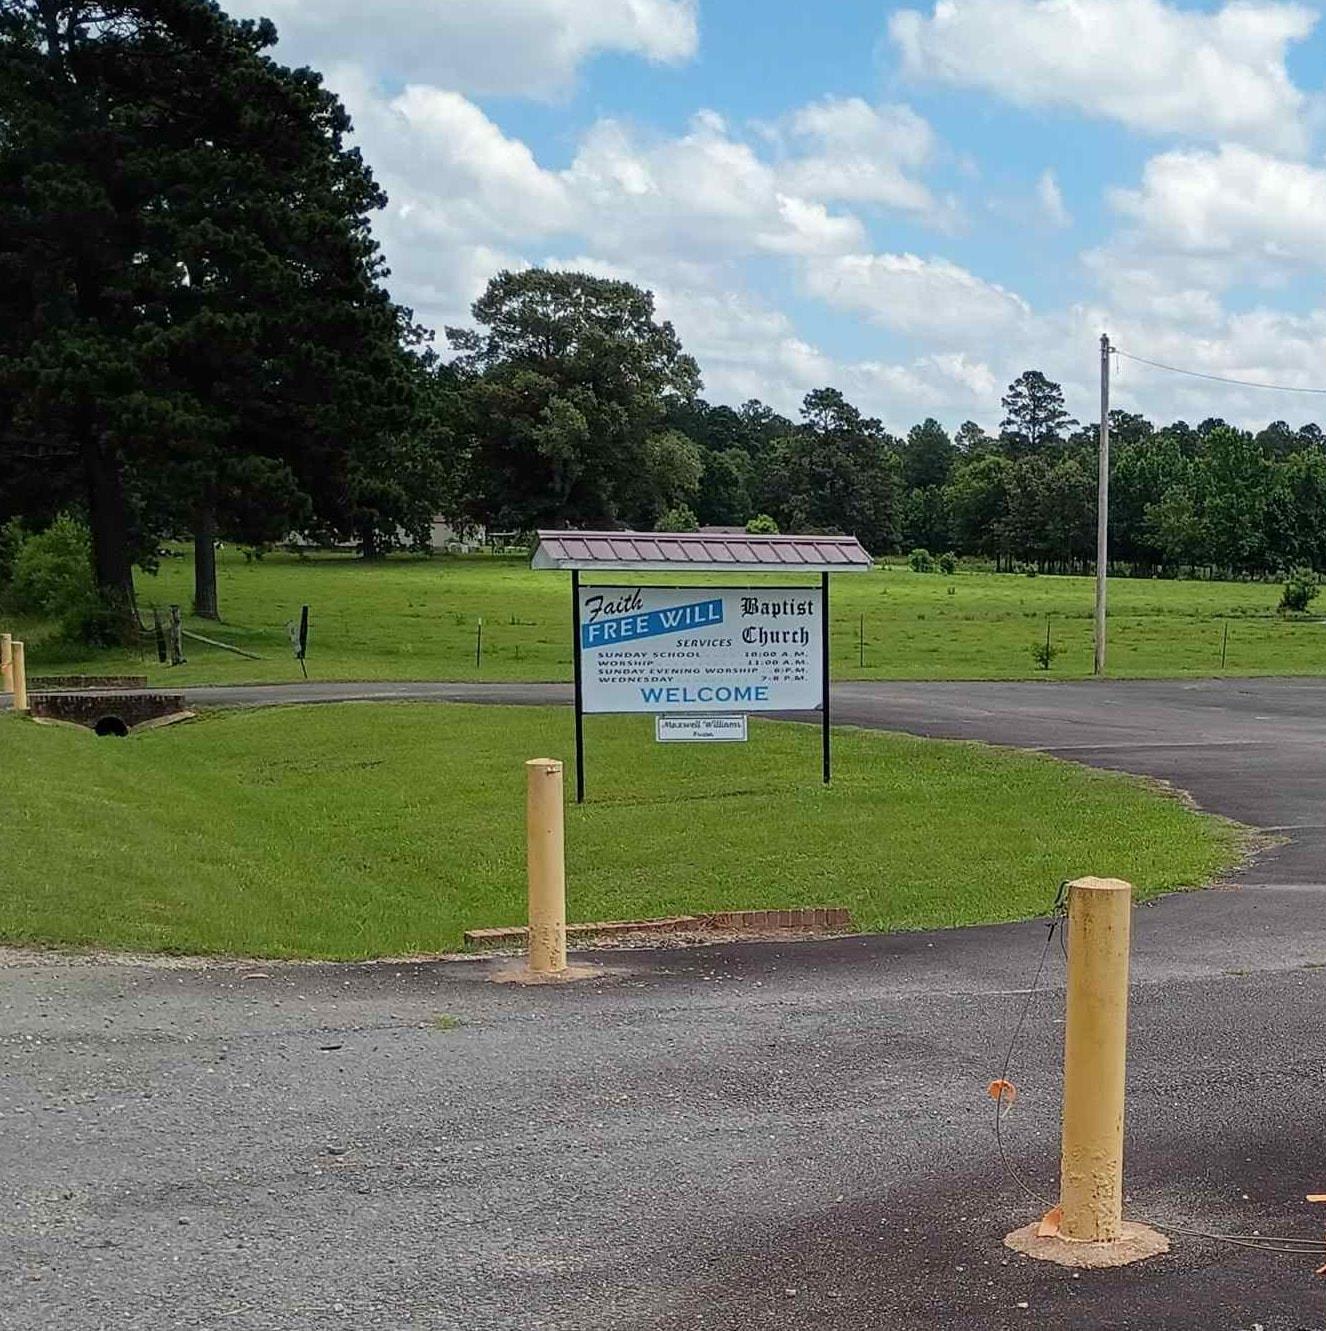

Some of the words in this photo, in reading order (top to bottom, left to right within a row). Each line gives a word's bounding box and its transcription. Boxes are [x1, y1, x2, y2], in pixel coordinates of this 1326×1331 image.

[585, 588, 645, 623] Faith
[740, 597, 814, 619] Baptist
[588, 615, 650, 643] FREE
[659, 604, 721, 629] WILL
[676, 638, 733, 648] SERVICES
[742, 626, 810, 647] Church
[597, 651, 648, 659] SUNDAY
[653, 651, 700, 659] SCHOOL
[597, 667, 646, 675] SUNDAY
[650, 667, 701, 675] EVENING
[641, 686, 769, 703] WELCOME
